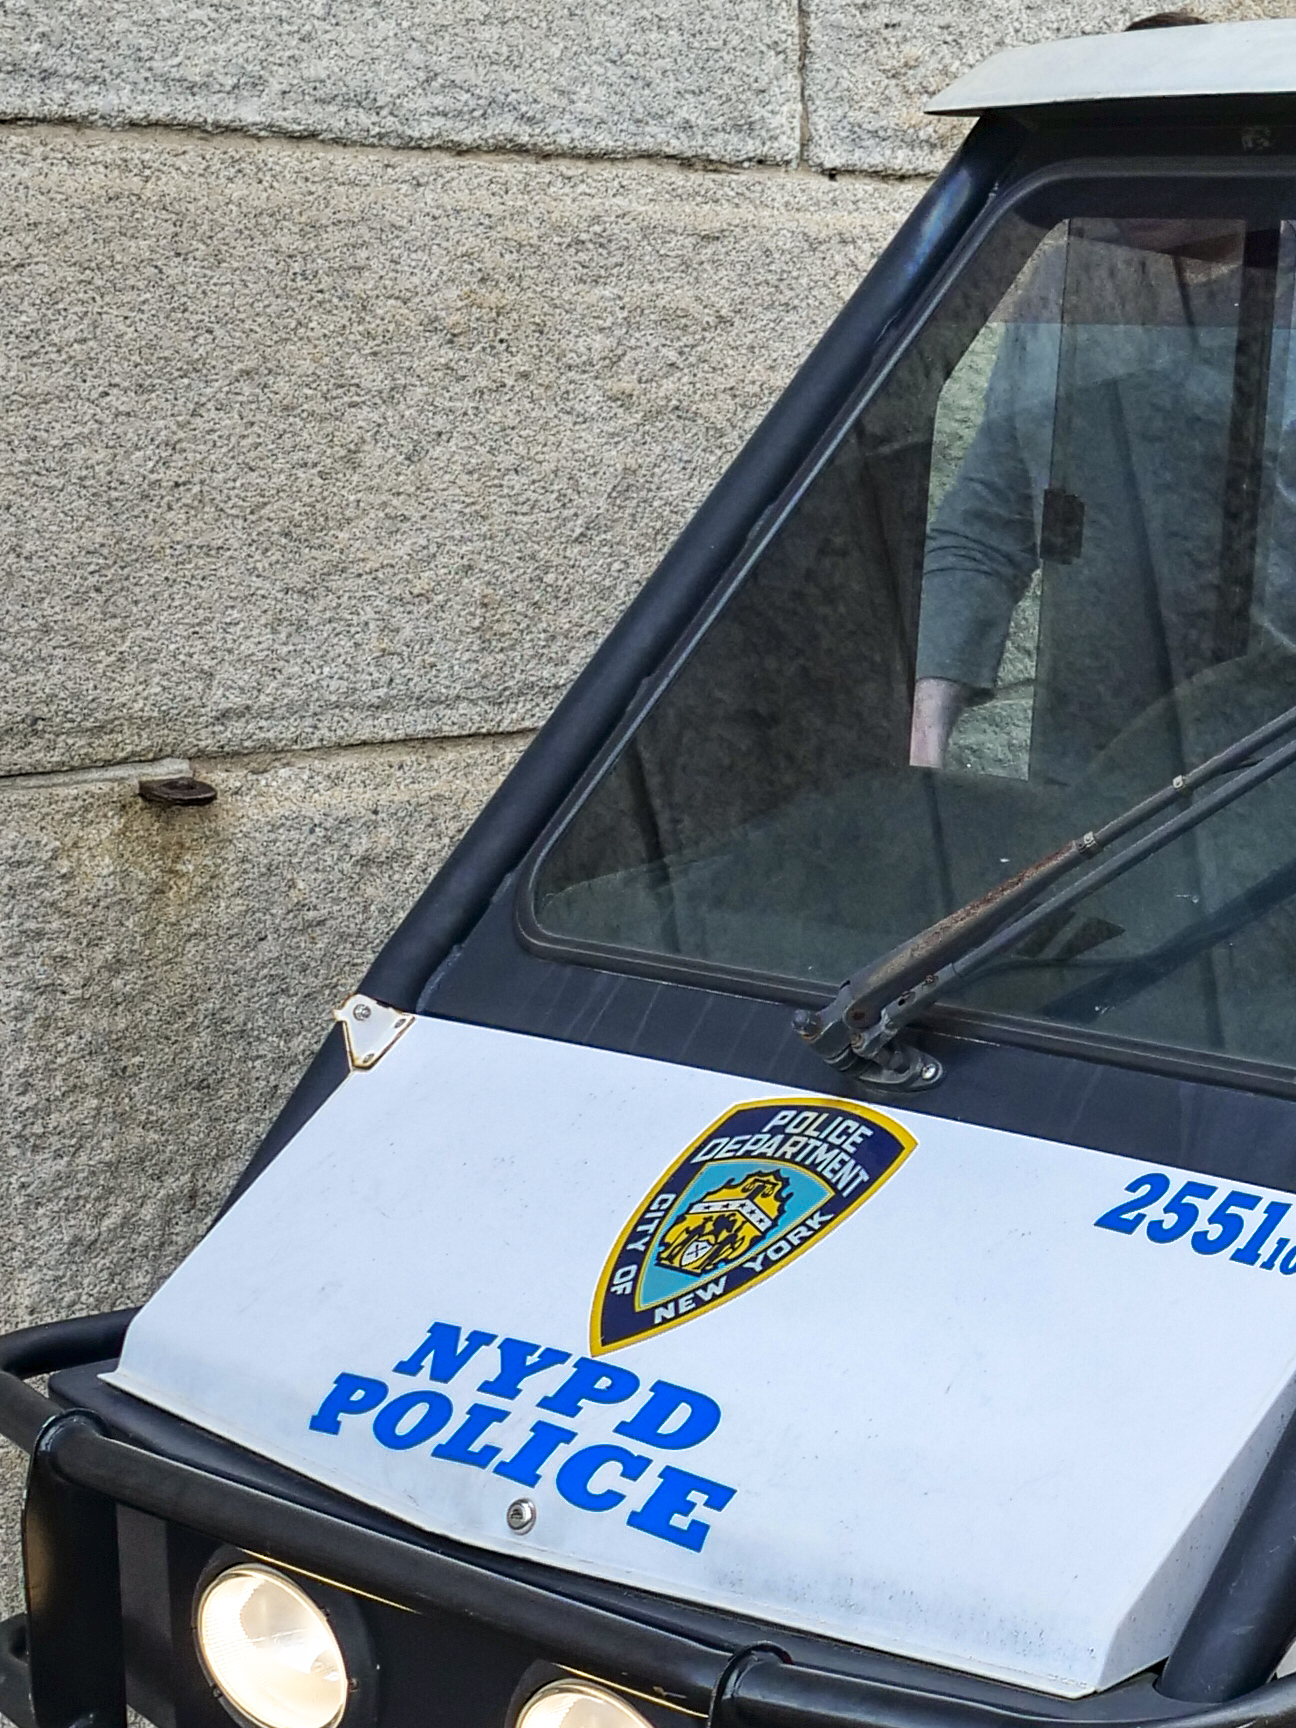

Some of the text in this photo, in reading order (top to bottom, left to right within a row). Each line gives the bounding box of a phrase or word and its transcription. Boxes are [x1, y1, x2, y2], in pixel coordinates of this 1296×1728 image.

[691, 1133, 869, 1198] DEPARTMENT
[763, 1110, 873, 1153] POLICE
[610, 1192, 835, 1324] CITY OF NEW YORK
[392, 1321, 721, 1450] NYPD
[309, 1372, 738, 1553] POLICE
